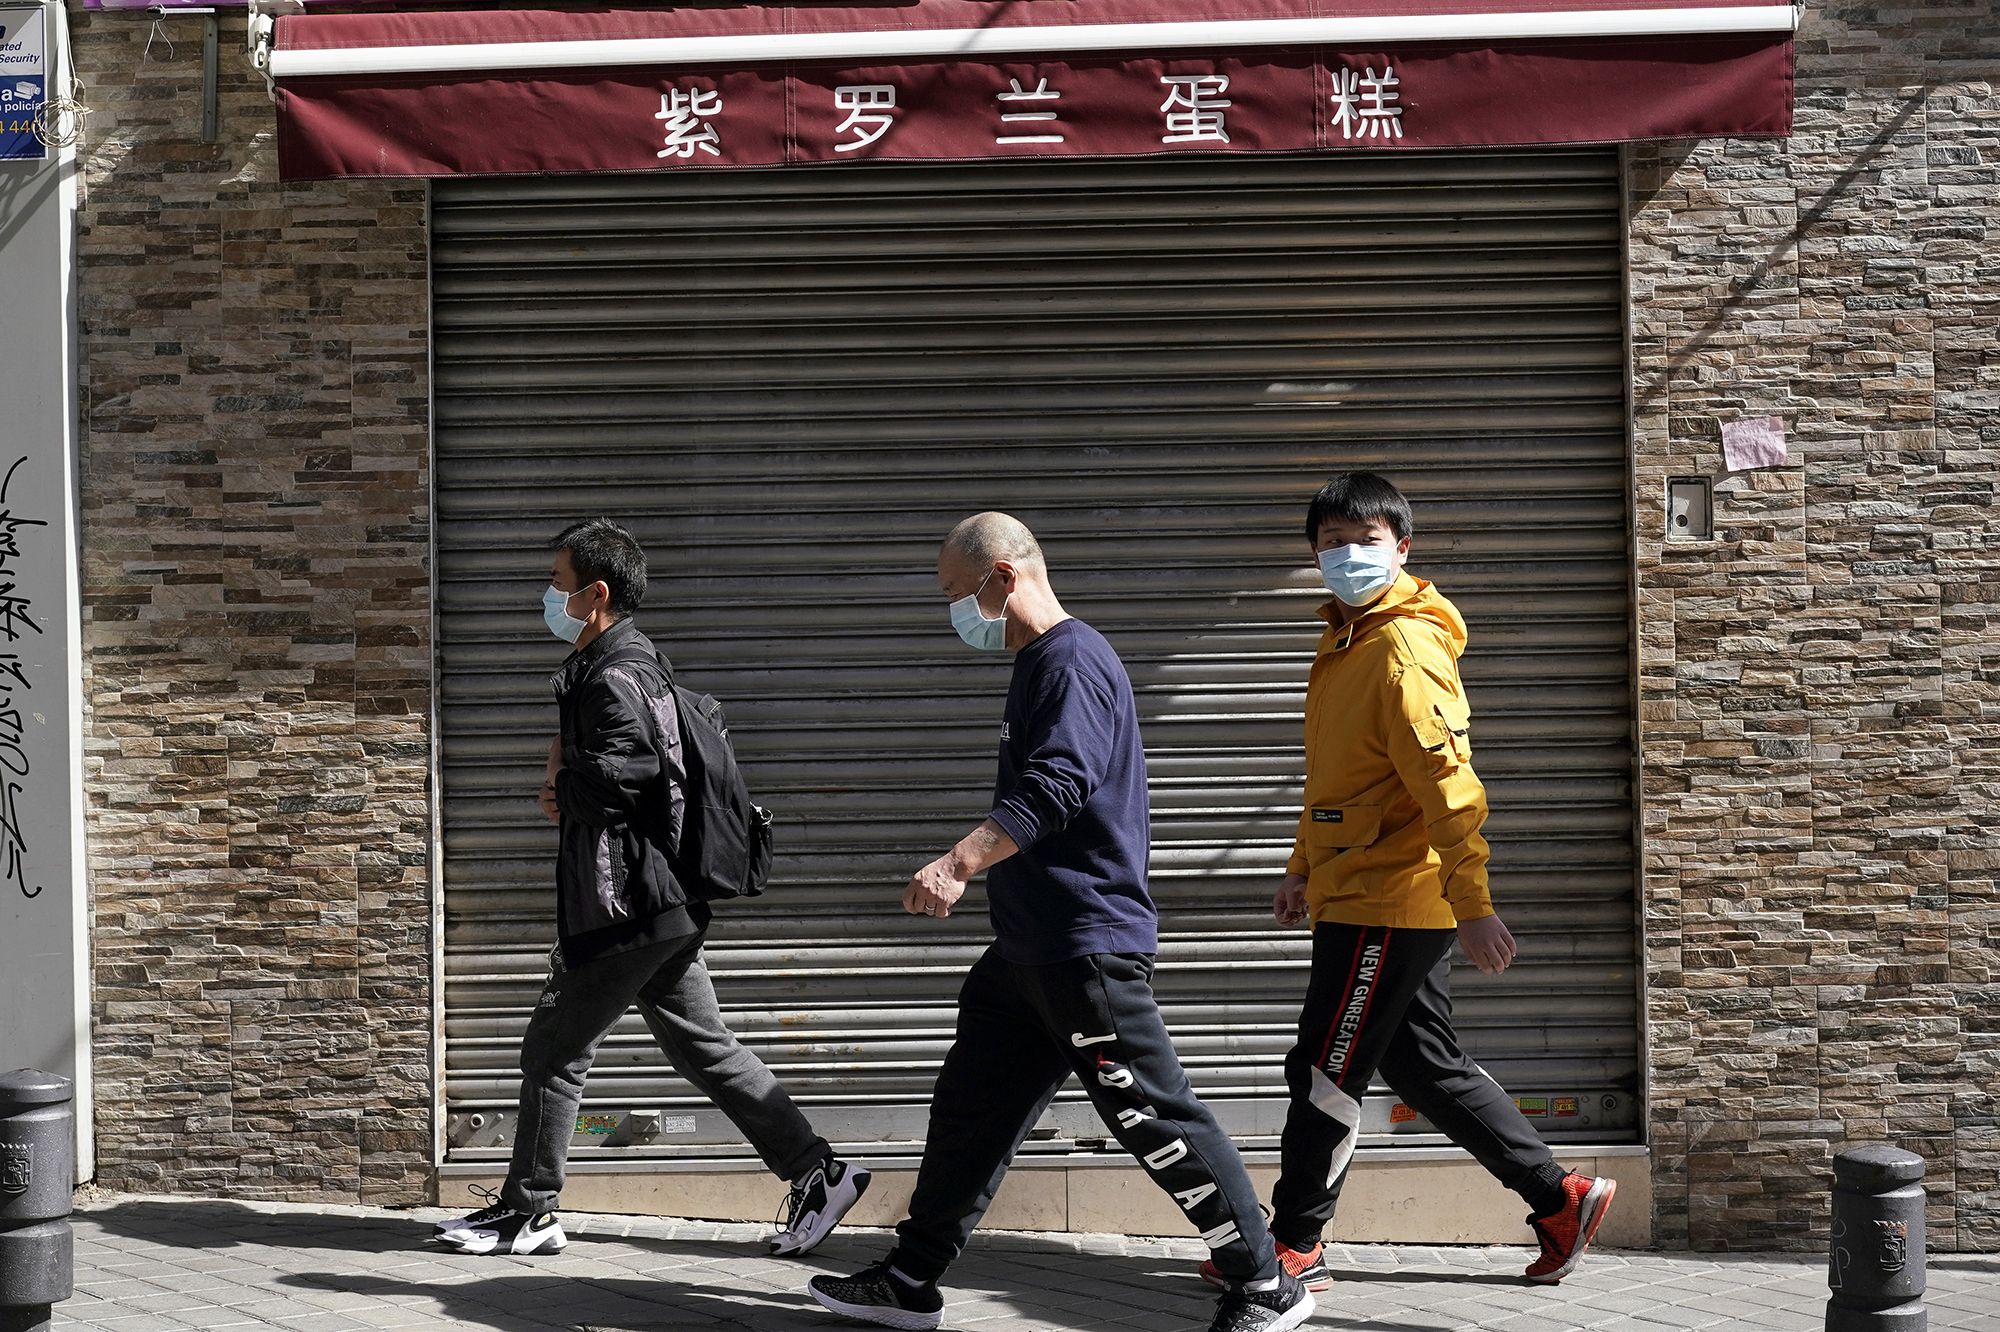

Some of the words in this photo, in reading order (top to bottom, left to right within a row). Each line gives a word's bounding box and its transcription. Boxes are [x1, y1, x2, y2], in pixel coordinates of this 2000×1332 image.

[655, 66, 1403, 158] 紫罗兰蛋糕
[1357, 945, 1382, 982] NEW
